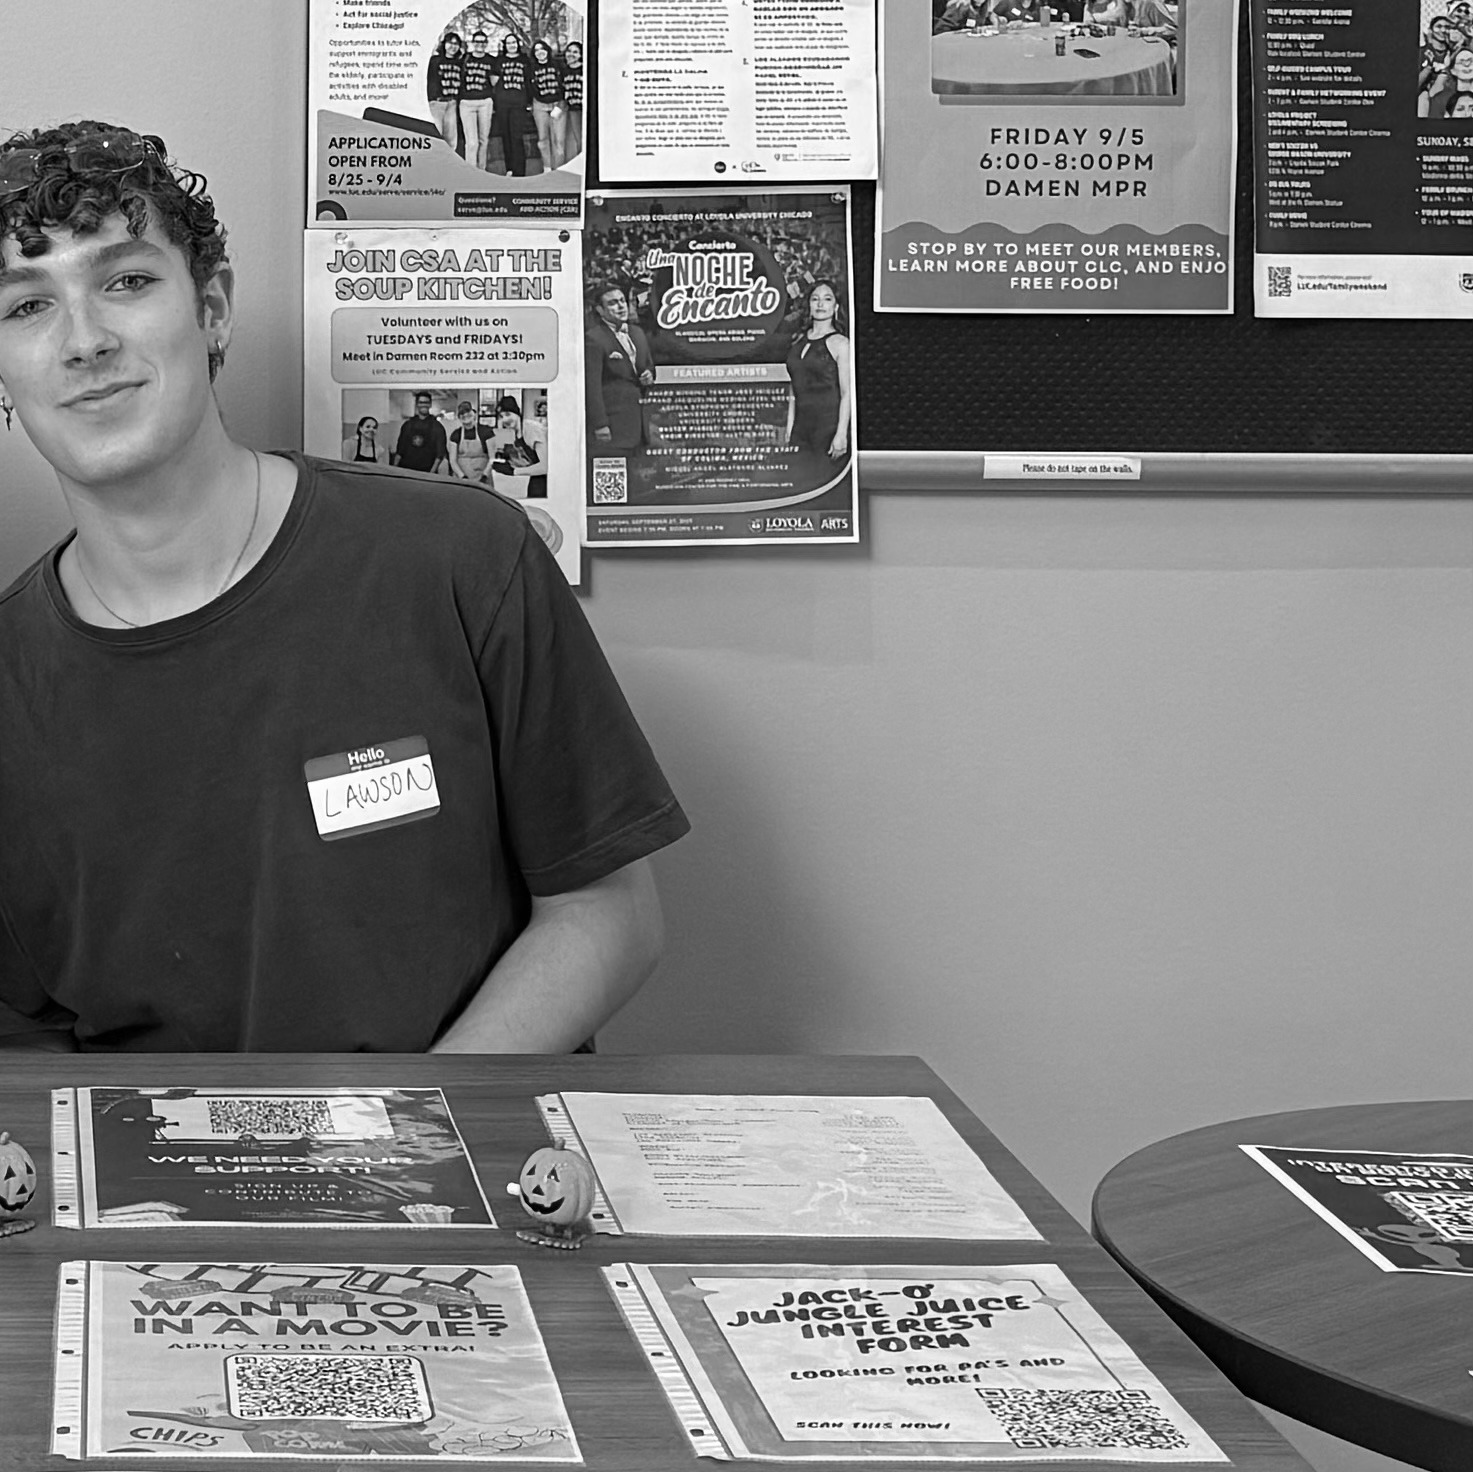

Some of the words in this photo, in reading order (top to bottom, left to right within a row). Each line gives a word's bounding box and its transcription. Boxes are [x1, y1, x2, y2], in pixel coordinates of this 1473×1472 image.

[328, 137, 432, 150] APPLICATIONS
[990, 128, 1087, 146] FRIDAY
[1099, 128, 1145, 146] 9/5
[1417, 136, 1461, 148] SUNDAY,
[328, 156, 367, 168] OPEN
[370, 156, 412, 168] FROM
[979, 153, 1154, 171] 6:00-8:00PM
[328, 173, 364, 187] 8/25
[376, 173, 402, 186] 9/4
[985, 180, 1080, 197] DAMEN
[1092, 180, 1148, 197] MPR
[652, 213, 694, 222] CONCIERTO
[694, 213, 705, 221] AT
[705, 213, 734, 221] LOYOLA
[735, 212, 778, 220] UNIVERSITY
[779, 211, 813, 219] CHICAGO
[688, 240, 737, 250] Concierto
[907, 242, 957, 256] STOP
[963, 242, 987, 256] BY
[993, 242, 1018, 256] TO
[1026, 243, 1074, 256] MEET
[1080, 243, 1119, 256] OUR
[1126, 243, 1221, 258] MEMBERS,
[327, 249, 396, 274] JOIN
[400, 249, 461, 272] CSA
[464, 249, 504, 272] AT
[507, 249, 562, 272] THE
[647, 248, 676, 268] Una
[675, 253, 754, 288] NOCHE
[888, 259, 948, 272] LEARN
[955, 259, 1008, 273] MORE
[1014, 259, 1079, 273] ABOUT
[1084, 260, 1129, 275] CLC,
[1134, 260, 1174, 273] AND
[1181, 261, 1227, 274] ENJO
[335, 277, 413, 301] SOUP
[417, 275, 552, 301] KITCHEN!
[693, 282, 716, 299] de
[1010, 277, 1053, 289] FREE
[1060, 277, 1118, 290] FOOD!
[657, 276, 780, 329] Encanto
[381, 316, 442, 327] Volunteer
[444, 316, 472, 327] with
[474, 318, 490, 327] us
[492, 318, 509, 327] on
[367, 334, 432, 346] TUESDAYS
[435, 334, 461, 345] and
[463, 334, 523, 345] FRIDAYS!
[342, 352, 371, 362] Meet
[373, 351, 384, 361] in
[386, 352, 427, 362] Damen
[429, 352, 463, 362] Room
[465, 352, 485, 361] 232
[487, 352, 500, 361] at
[502, 352, 545, 364] 3:30pm
[673, 367, 725, 378] FEATURED
[726, 366, 768, 377] ARTISTS
[1022, 464, 1045, 473] Please
[1046, 464, 1056, 473] do
[1057, 464, 1070, 473] not
[1071, 465, 1087, 473] tape
[1099, 464, 1111, 473] the
[1113, 464, 1133, 473] walls.
[766, 517, 813, 528] LOYOLA
[821, 518, 848, 529] ARTS
[347, 748, 385, 766] Hello
[325, 763, 433, 818] LAWSON
[309, 1156, 413, 1165] YOUR
[194, 1165, 371, 1174] SUPPORT!
[129, 1300, 317, 1317] WANT
[333, 1301, 418, 1318] TO
[436, 1303, 506, 1319] BE
[725, 1301, 888, 1327] JUNGLE
[905, 1295, 1032, 1316] JUICE
[133, 1318, 193, 1334] IN
[212, 1318, 259, 1336] A
[276, 1318, 508, 1337] MOVIE?
[800, 1313, 996, 1339] INTEREST
[856, 1333, 971, 1355] FORM
[790, 1367, 897, 1381] LOOKING
[904, 1364, 948, 1376] FOR
[957, 1358, 1011, 1372] PA'S
[1018, 1356, 1066, 1368] AND
[905, 1374, 982, 1387] MORE!
[795, 1421, 845, 1430] SCAN
[851, 1421, 894, 1430] THIS
[899, 1421, 952, 1430] NOW!
[129, 1427, 225, 1447] CHIPS
